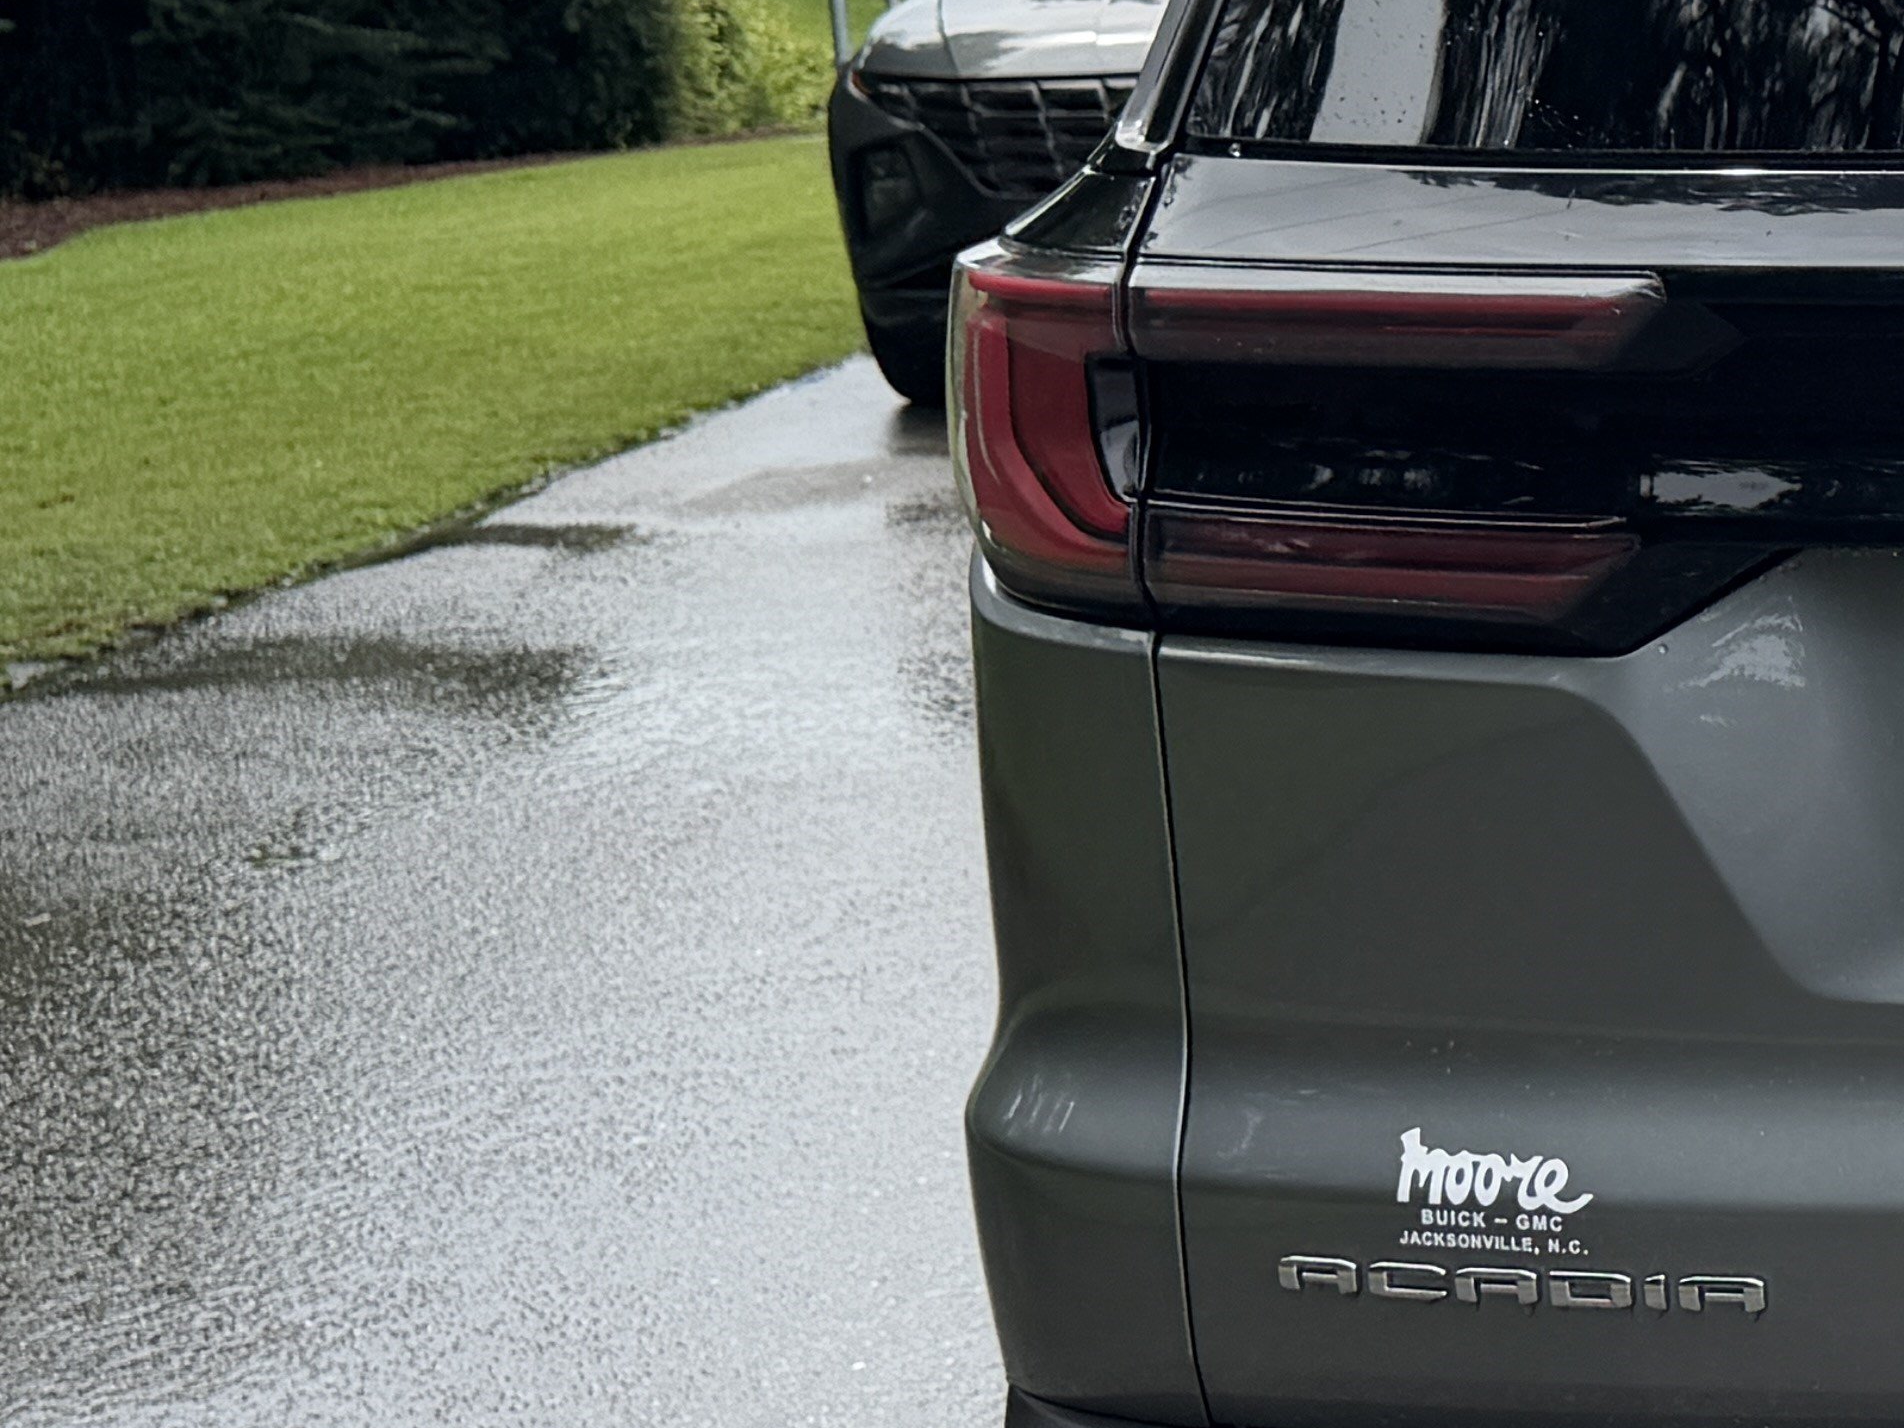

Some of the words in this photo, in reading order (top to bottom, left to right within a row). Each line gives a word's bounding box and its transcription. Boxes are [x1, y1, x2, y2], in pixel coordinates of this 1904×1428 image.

[1420, 1207, 1487, 1229] BUICK
[1515, 1213, 1564, 1233] GMC
[1399, 1229, 1540, 1256] JACKSONVILLE,
[1548, 1237, 1590, 1256] N.C.
[1277, 1254, 1766, 1313] ACADIA
